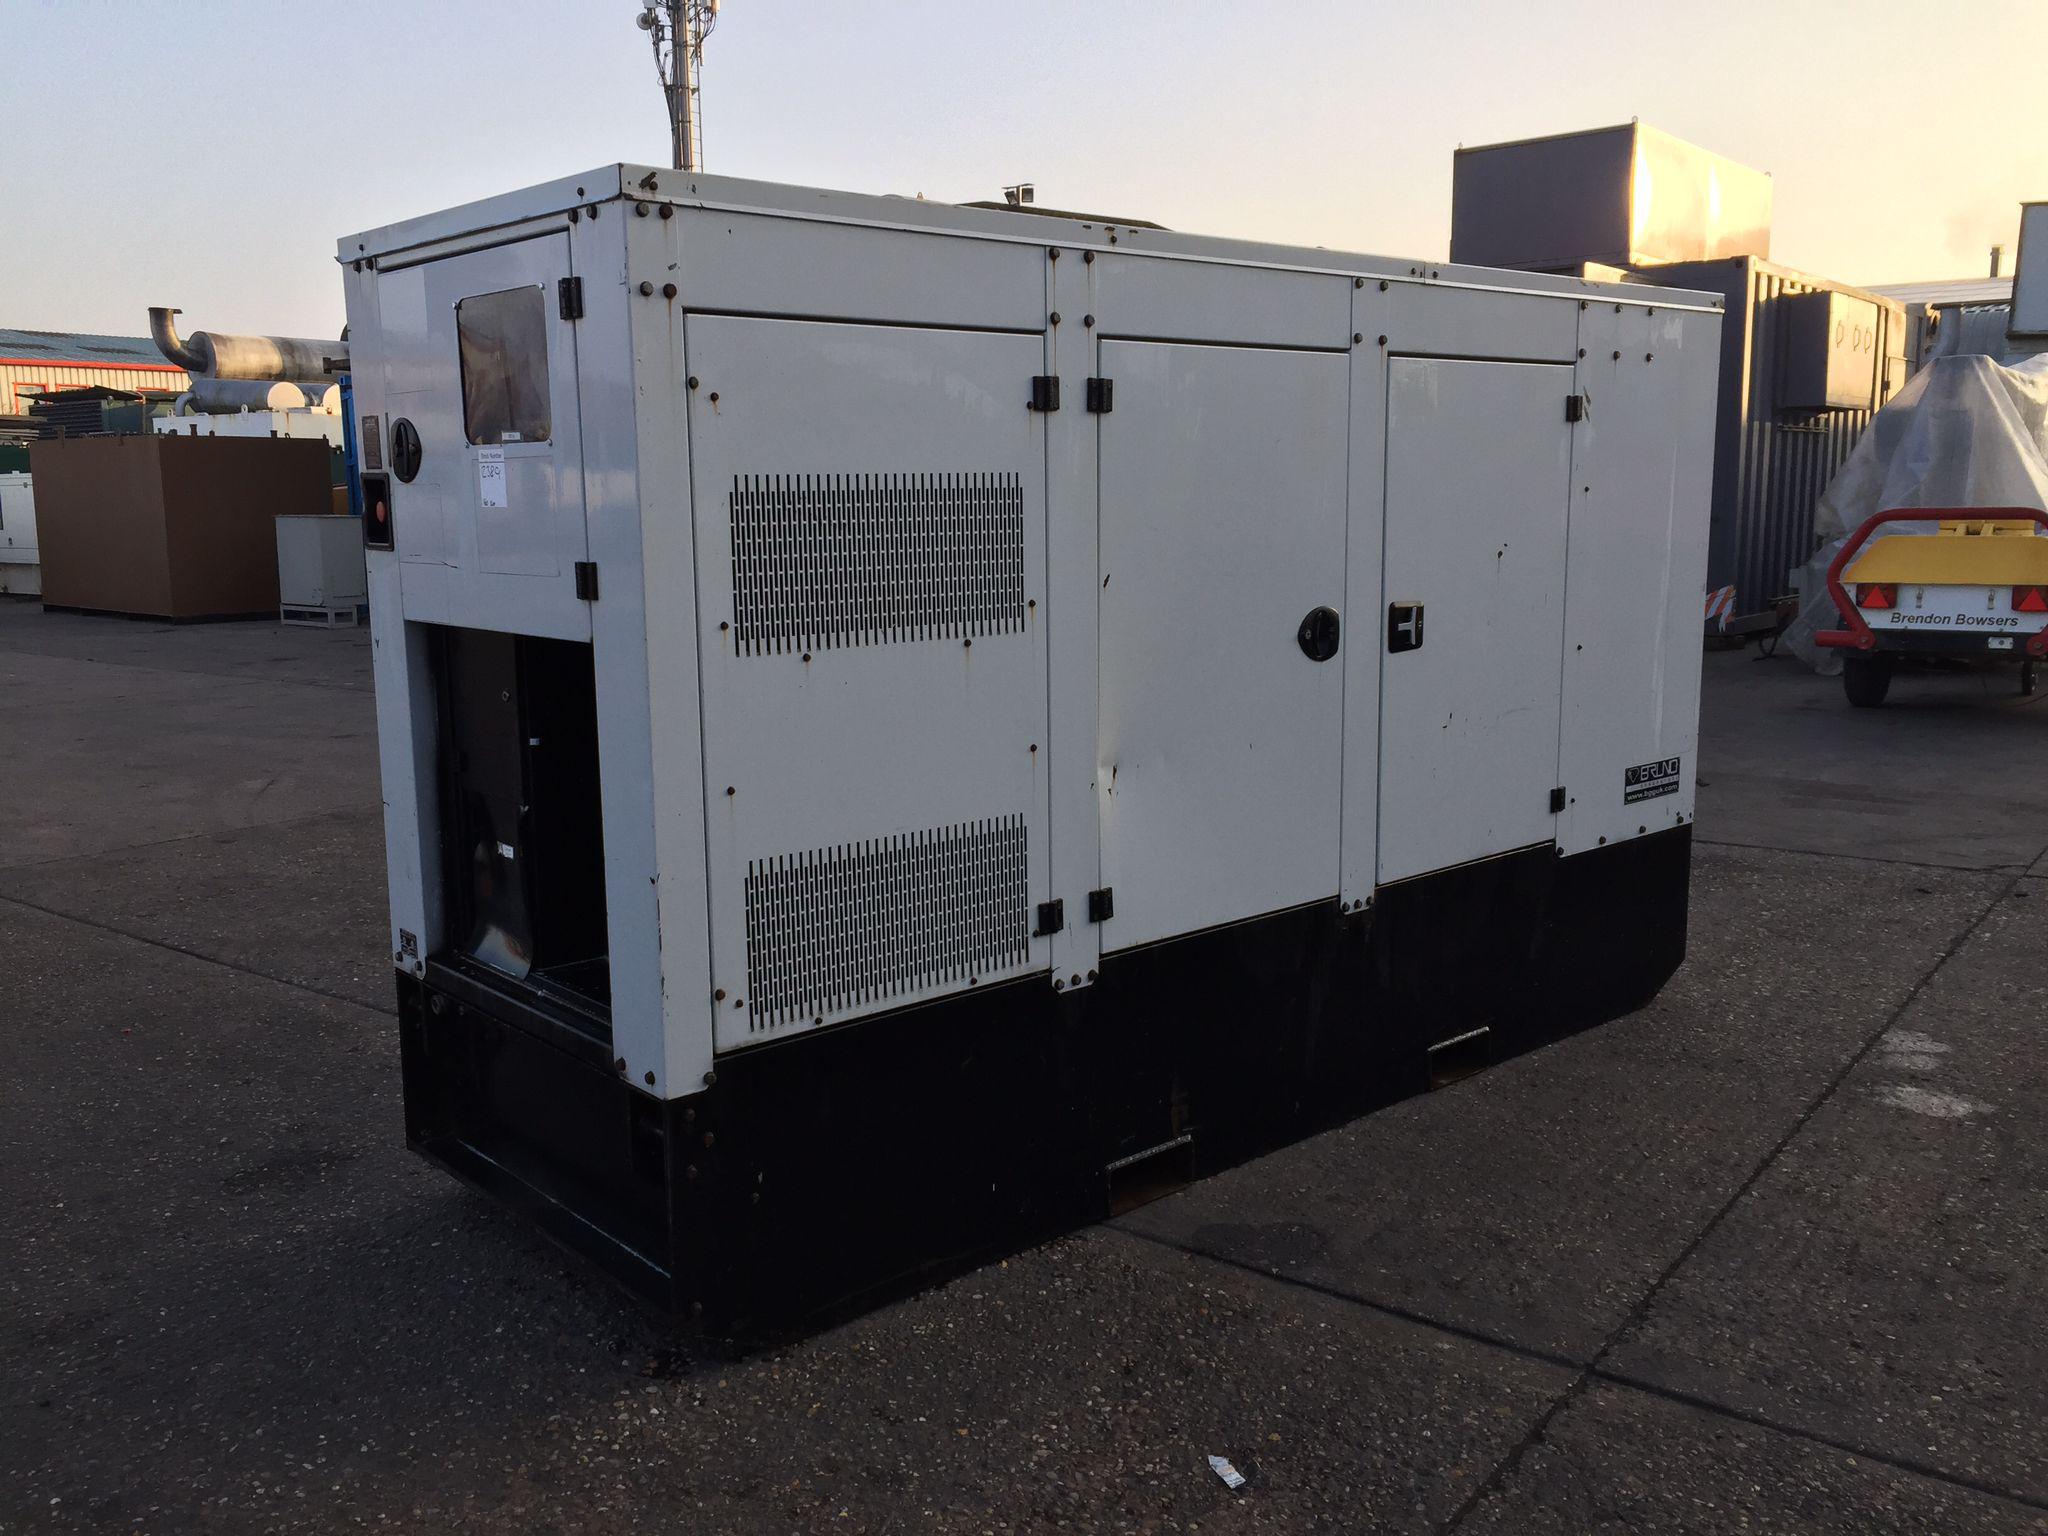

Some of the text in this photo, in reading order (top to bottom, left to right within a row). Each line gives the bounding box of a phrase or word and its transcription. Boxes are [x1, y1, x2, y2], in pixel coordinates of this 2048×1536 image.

[1891, 612, 2019, 627] Brendon Bowsers
[1640, 759, 1679, 781] BRUNO
